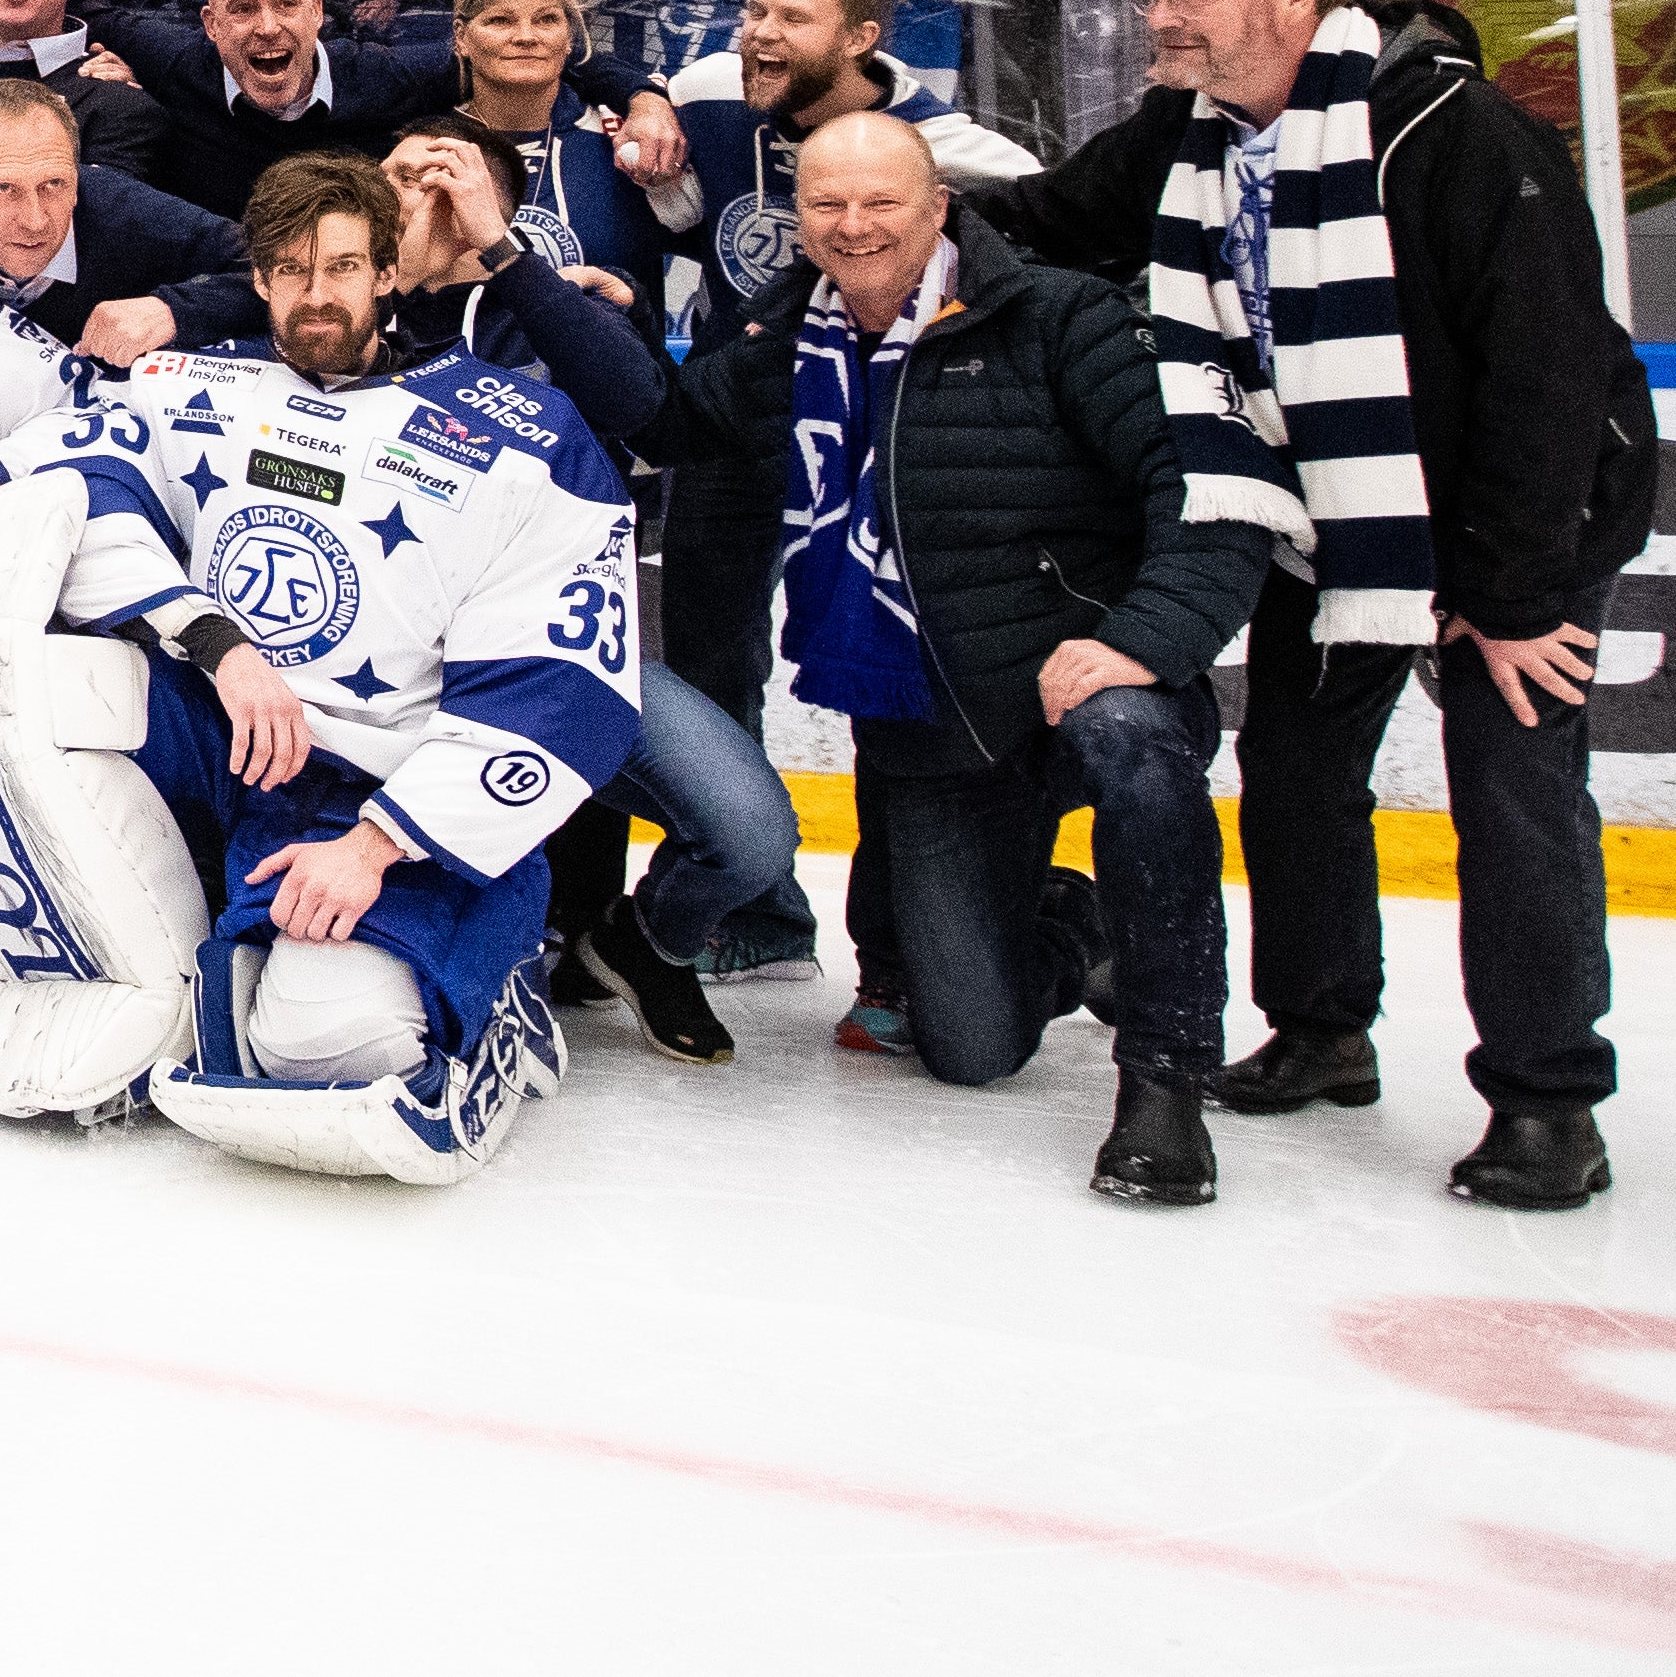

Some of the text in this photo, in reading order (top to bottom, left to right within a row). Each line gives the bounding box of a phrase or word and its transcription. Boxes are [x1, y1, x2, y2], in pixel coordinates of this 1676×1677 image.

[187, 366, 237, 385] Insjön
[193, 357, 263, 377] Bergkvist
[405, 352, 461, 379] TEGERA
[290, 397, 345, 418] CCM
[477, 375, 542, 417] clas
[163, 408, 235, 423] ERLANDSSON
[457, 387, 559, 450] ohlson
[277, 429, 342, 456] TEGERA
[407, 424, 490, 463] LEKSANDS
[255, 456, 336, 488] GRÖNSAKS
[273, 475, 322, 497] HUSET
[375, 455, 458, 497] dalakraft
[249, 505, 361, 645] IDROTTSFORENING
[501, 762, 538, 794] 19
